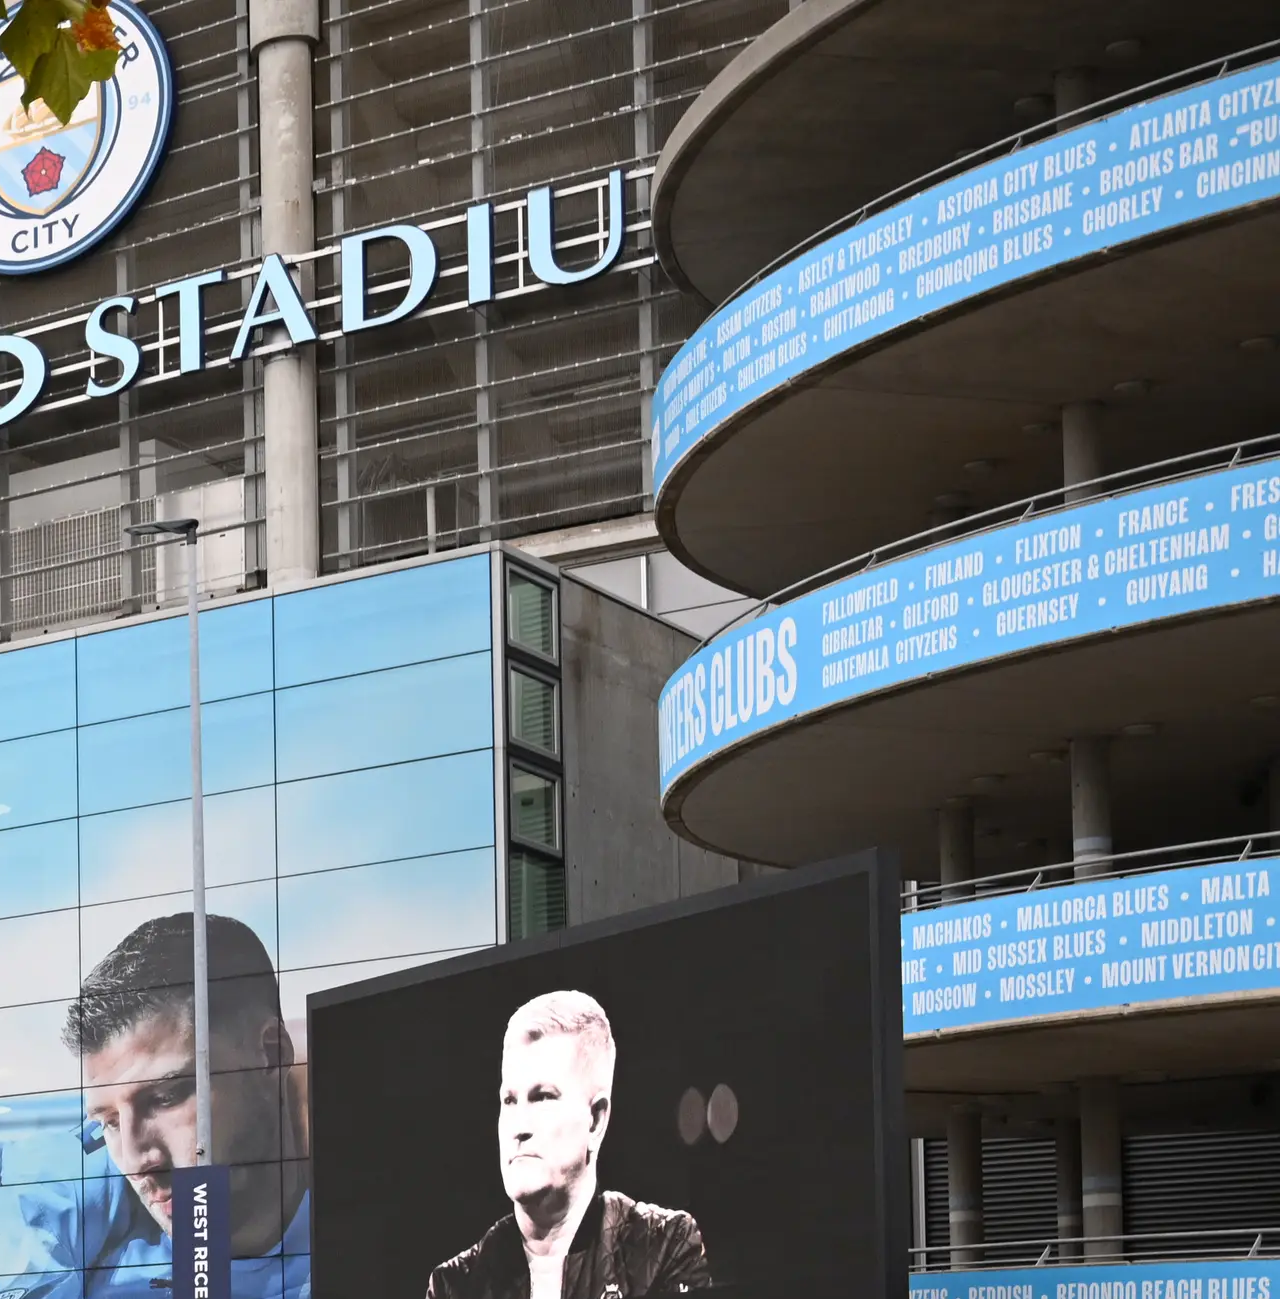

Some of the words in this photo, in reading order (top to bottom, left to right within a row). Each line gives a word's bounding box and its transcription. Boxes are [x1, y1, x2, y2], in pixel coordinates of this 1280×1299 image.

[11, 213, 81, 254] CITY
[716, 309, 742, 348] ASSAM
[743, 284, 783, 328] CITYZENS
[798, 252, 835, 295] ASTLEY
[847, 213, 913, 267] TYLDESLEY
[937, 177, 999, 225] ASTORIA
[1003, 161, 1039, 198] CITY
[1043, 139, 1097, 183] BLUES
[1128, 99, 1212, 151] ATLANTA
[722, 335, 751, 374] BOLTON
[761, 305, 797, 346] BOSTON
[809, 263, 881, 318] BRANTWOOD
[898, 221, 971, 275] BREDBURY
[992, 181, 1074, 235] BRISBANE
[1099, 147, 1175, 196] BROOKS
[1178, 133, 1219, 169] BAR
[737, 353, 776, 392] CHILTERN
[778, 331, 808, 368] BLUES
[823, 287, 895, 343] CHITTAGONG
[915, 244, 999, 300] CHONGQING
[1003, 223, 1054, 265] BLUES
[1082, 184, 1164, 236] CHORLEY
[822, 577, 899, 626] FALLOWFIELD
[925, 551, 984, 591] FINLAND
[1015, 524, 1082, 565] FLIXTON
[1118, 496, 1190, 539] FRANCE
[822, 615, 884, 658] GIBRALTAR
[903, 592, 960, 631] GILFORD
[982, 558, 1083, 608] GLOUCESTER
[1087, 554, 1100, 581] &
[1104, 523, 1230, 577] CHELTENHAM
[710, 616, 798, 737] CLUBS
[822, 645, 890, 689] GUATEMALA
[895, 625, 958, 666] CITYZENS
[996, 592, 1080, 638] GUERNSEY
[1126, 563, 1209, 607] GUIYANG
[912, 913, 992, 950] MACHAKOS
[1016, 893, 1108, 933] MALLORCA
[1112, 884, 1170, 919] BLUES
[1201, 870, 1271, 905] MALTA
[952, 949, 982, 977] MID
[987, 937, 1048, 971] SUSSEX
[1053, 928, 1107, 961] BLUES
[1141, 908, 1253, 949] MIDDLETON
[912, 982, 977, 1016] MOSCOW
[999, 967, 1076, 1003] MOSSLEY
[1101, 956, 1168, 989] MOUNT
[1172, 945, 1250, 980] VERNON
[193, 1182, 208, 1241] WEST
